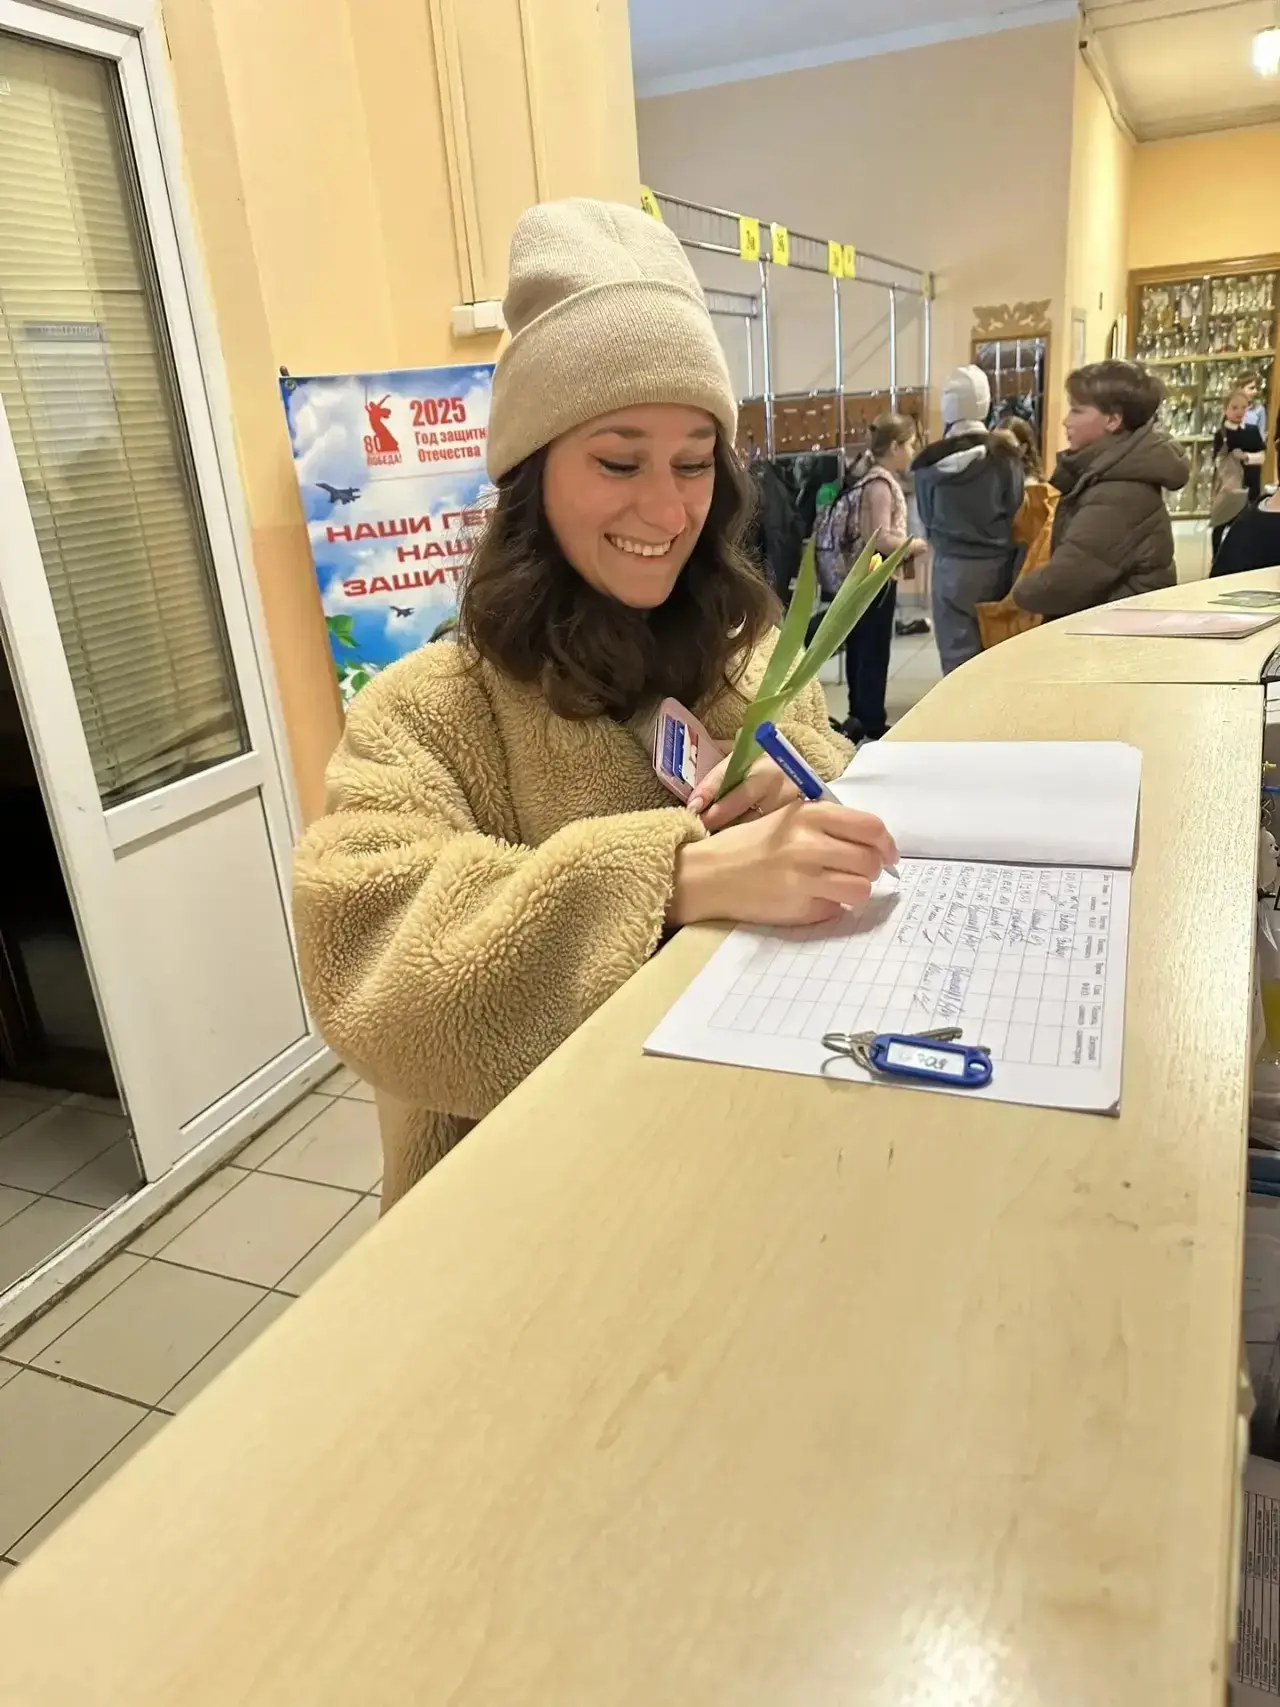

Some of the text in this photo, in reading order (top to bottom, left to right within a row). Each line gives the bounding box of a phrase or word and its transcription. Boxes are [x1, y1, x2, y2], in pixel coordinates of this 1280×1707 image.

[409, 397, 466, 426] 2025
[415, 427, 487, 446] Год защитн
[418, 445, 481, 463] Отечества
[326, 508, 488, 543] НАШИ ГЕ
[397, 538, 474, 562] НАШ
[342, 565, 464, 597] ЗАЩИТ
